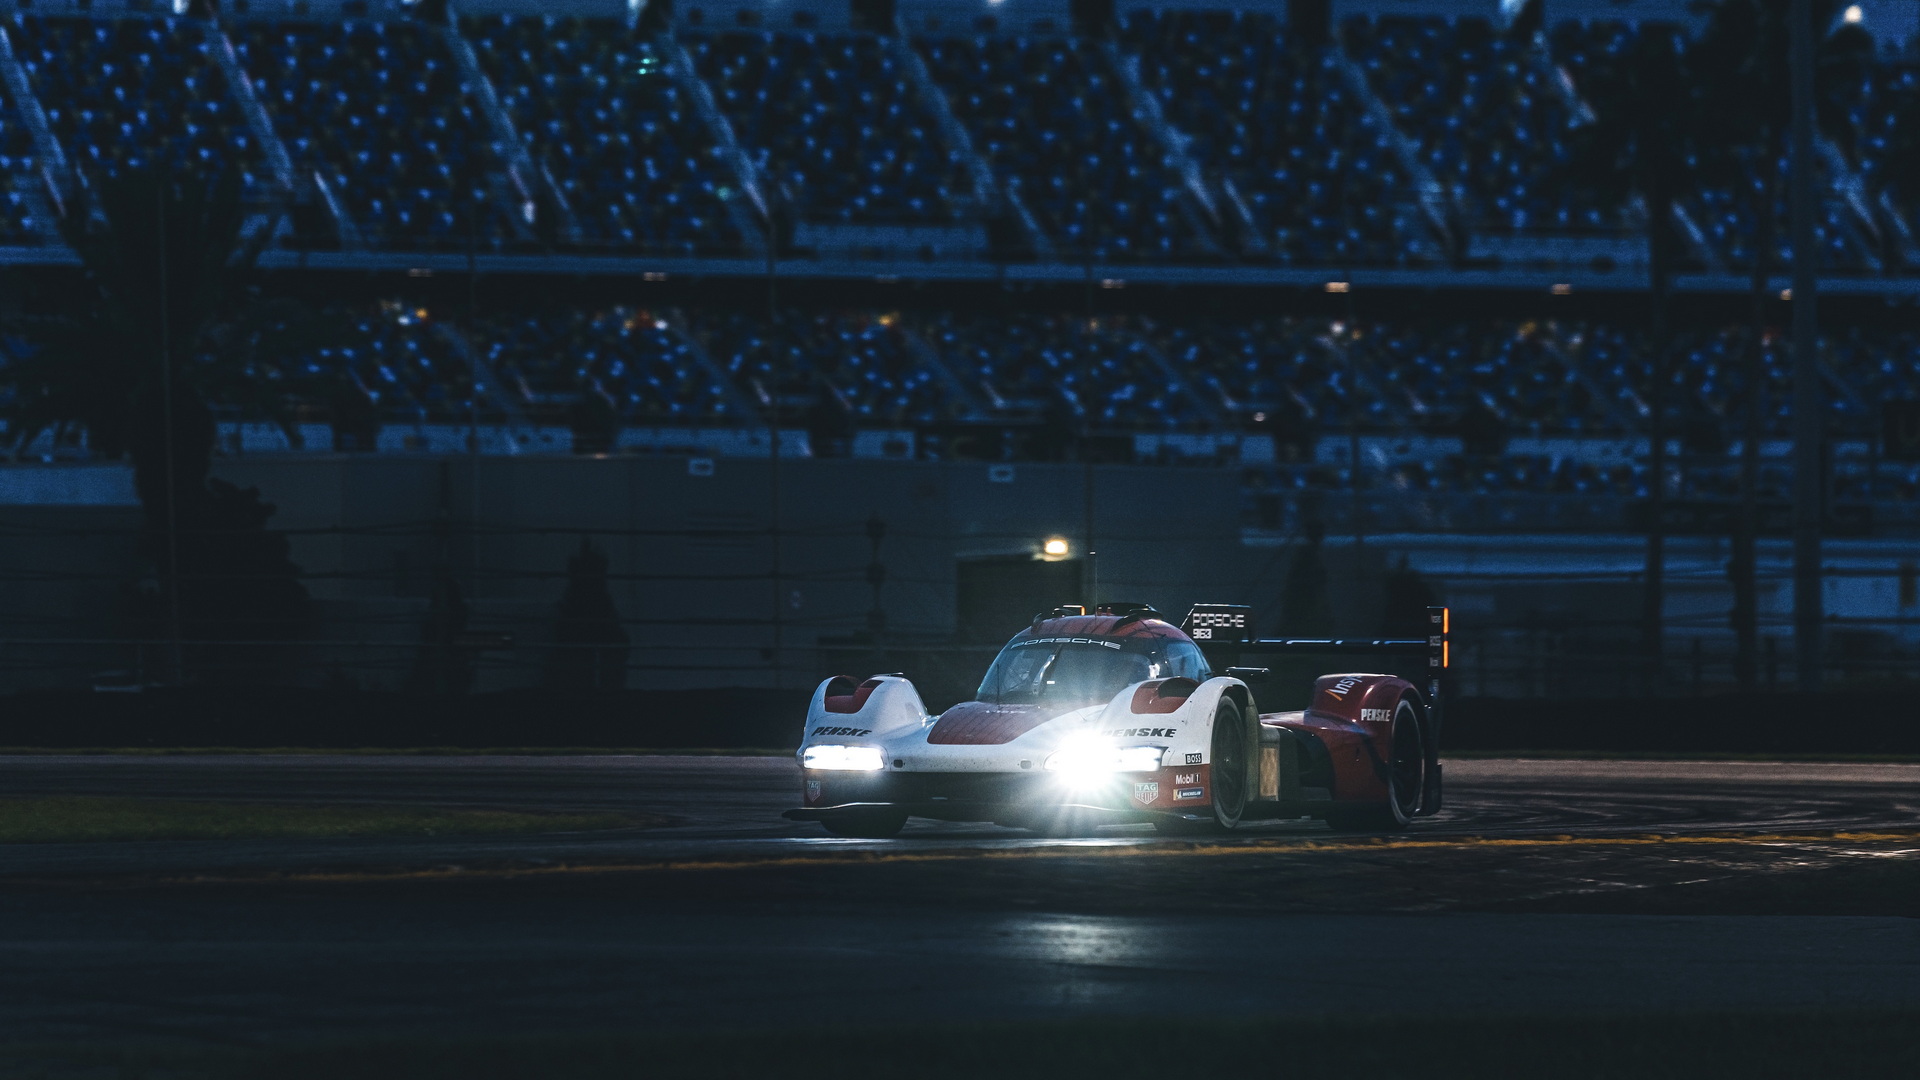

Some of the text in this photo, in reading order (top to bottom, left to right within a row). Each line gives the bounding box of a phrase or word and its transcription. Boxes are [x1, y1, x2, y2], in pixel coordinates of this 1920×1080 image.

[1193, 613, 1245, 628] PORSCHE
[1193, 629, 1212, 639] 963
[1010, 638, 1121, 650] PORSCHE
[1361, 708, 1391, 722] PENSKE
[811, 727, 872, 737] PENSKE
[1186, 754, 1202, 764] BOSS
[1175, 773, 1194, 785] Mobil
[1137, 784, 1157, 792] TAG
